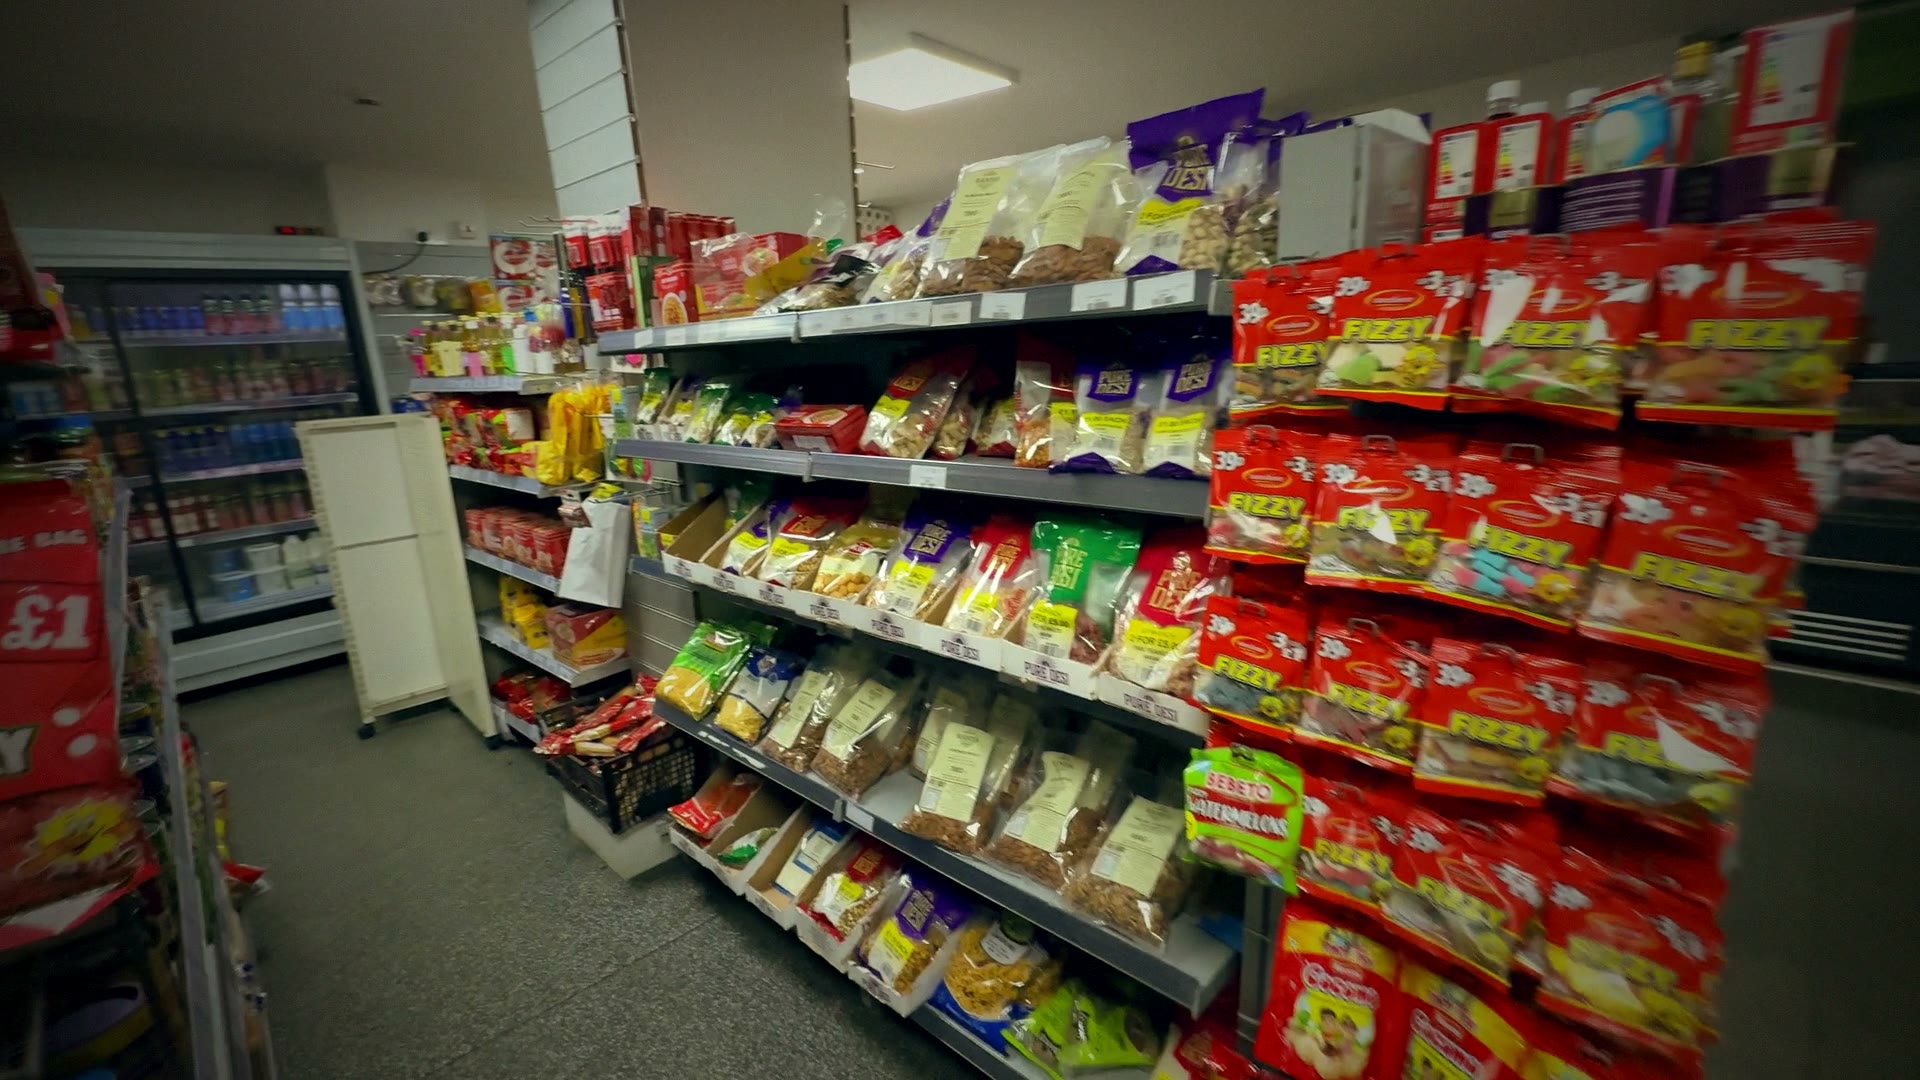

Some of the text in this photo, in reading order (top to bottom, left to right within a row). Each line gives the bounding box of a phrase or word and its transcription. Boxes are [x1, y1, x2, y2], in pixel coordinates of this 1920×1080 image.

[1342, 316, 1432, 342] FIZZY
[1687, 317, 1830, 351] FIZZY
[1228, 492, 1306, 520] FIZZY
[1632, 551, 1768, 606] FIZZY
[1, 594, 92, 650] £1
[941, 640, 980, 661] PURE DESI
[1024, 661, 1070, 686] PURE DESI
[1214, 654, 1283, 691] FIZZY
[1123, 693, 1178, 723] PURE DESI
[1328, 681, 1411, 723] FIZZY
[1448, 709, 1550, 754] FIZZY
